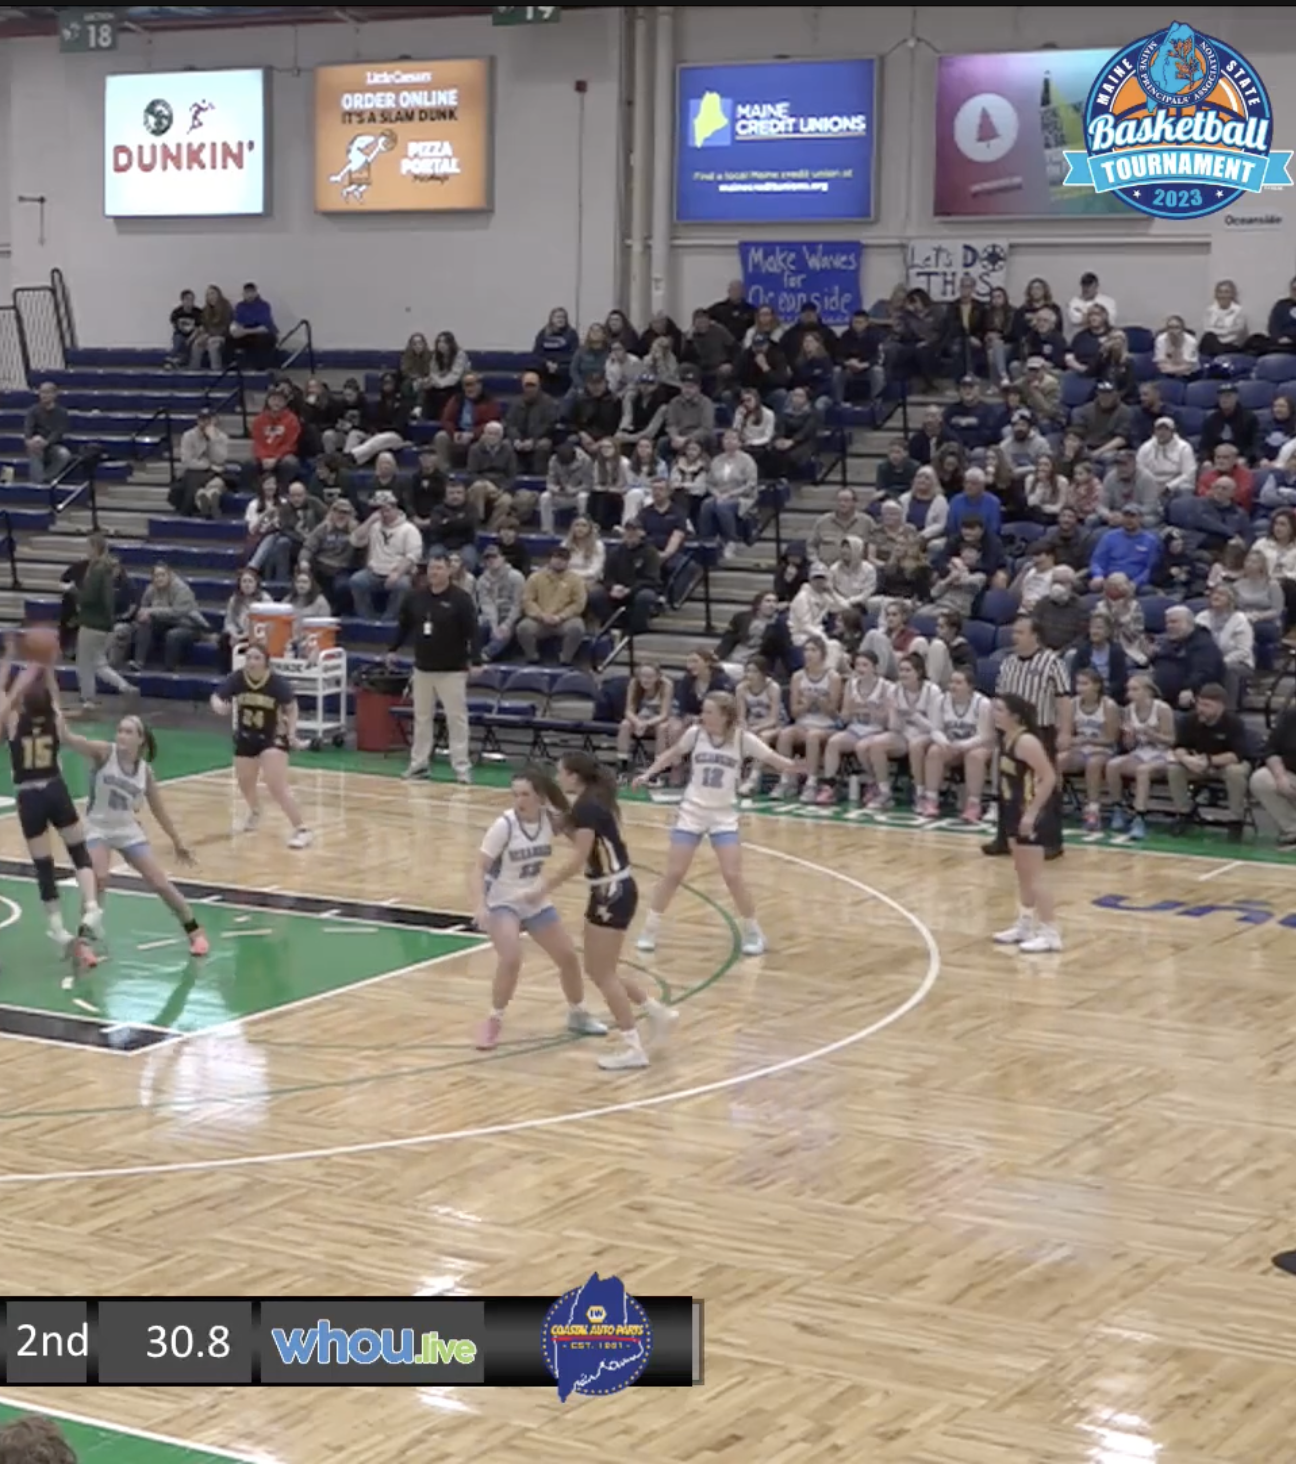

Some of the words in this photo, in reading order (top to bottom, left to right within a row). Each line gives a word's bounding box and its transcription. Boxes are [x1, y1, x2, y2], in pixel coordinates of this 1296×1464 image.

[88, 24, 112, 48] 18
[341, 92, 396, 110] ORDER
[399, 89, 459, 107] ONLINE
[341, 111, 365, 124] IT'S
[366, 111, 378, 124] A
[381, 110, 415, 124] SLAM
[418, 107, 458, 122] DUNK
[736, 102, 791, 119] MAINE
[735, 118, 797, 135] CREDIT
[799, 115, 867, 133] UNIONS
[113, 140, 255, 173] DUNKIN'
[407, 141, 453, 158] PIZZA
[400, 157, 461, 174] PORTAL
[1225, 214, 1283, 227] Oceanside
[749, 246, 796, 272] Make
[803, 244, 857, 271] Waves
[783, 272, 806, 288] for
[916, 271, 993, 301] THS
[749, 285, 853, 313] Oceanside
